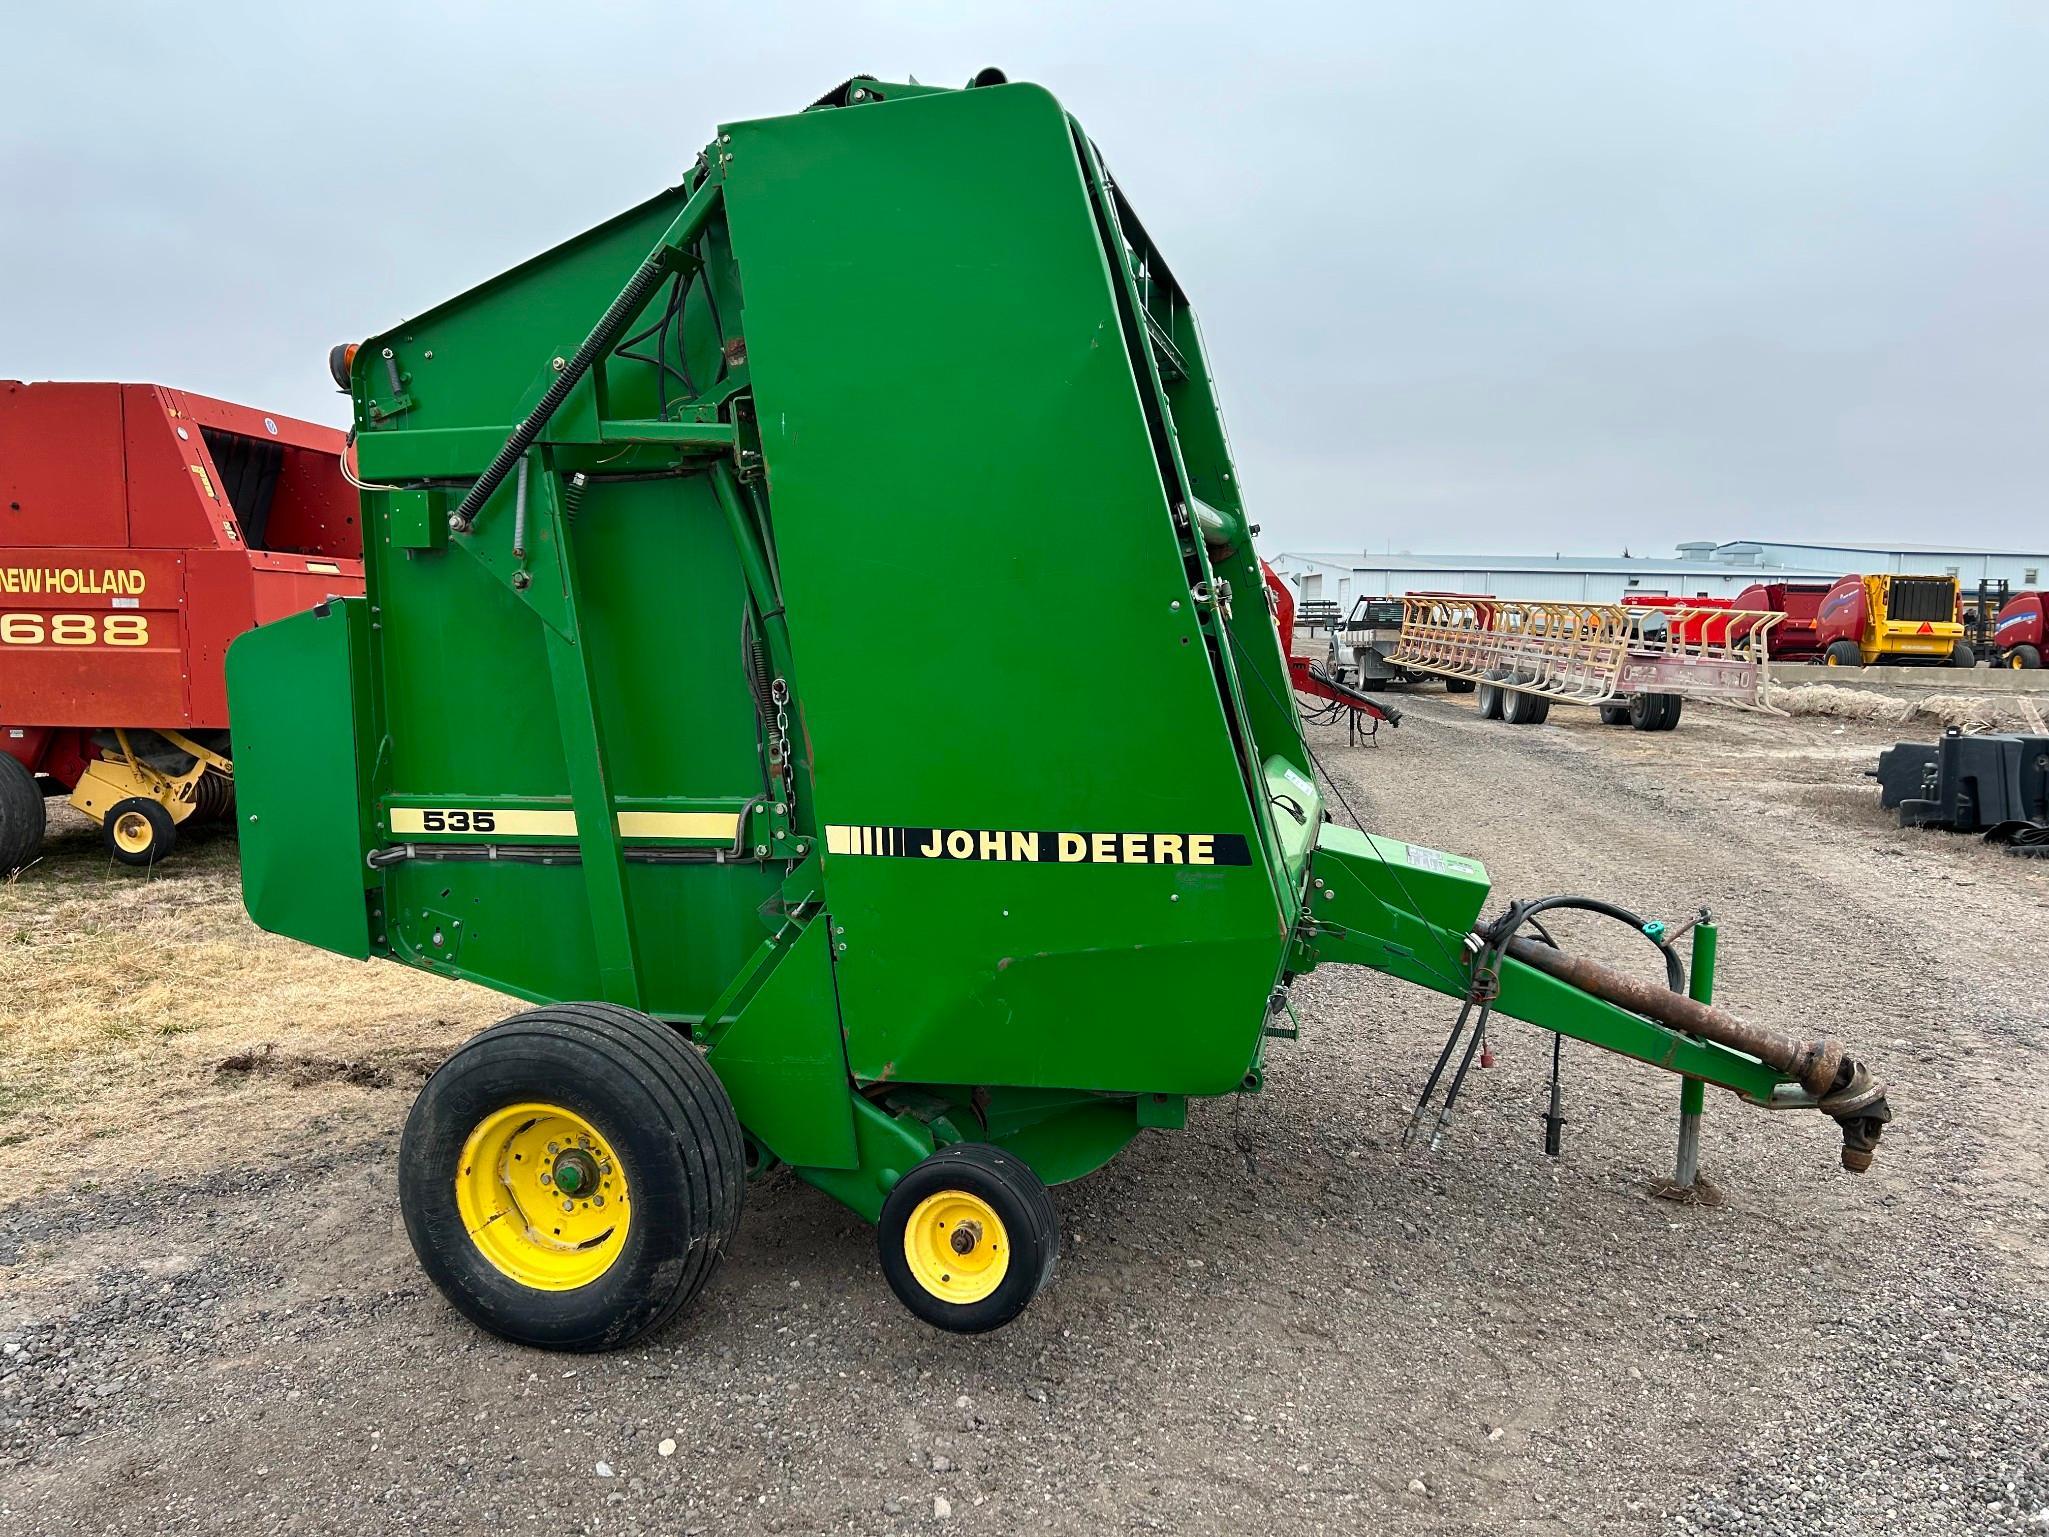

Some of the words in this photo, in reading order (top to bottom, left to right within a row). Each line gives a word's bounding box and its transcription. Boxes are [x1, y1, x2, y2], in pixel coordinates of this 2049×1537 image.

[0, 568, 42, 593] NEW
[45, 568, 146, 595] HOLLAND
[0, 613, 149, 646] 688
[423, 811, 496, 832] 535
[920, 829, 1039, 862] JOHN
[1058, 832, 1215, 865] DEERE
